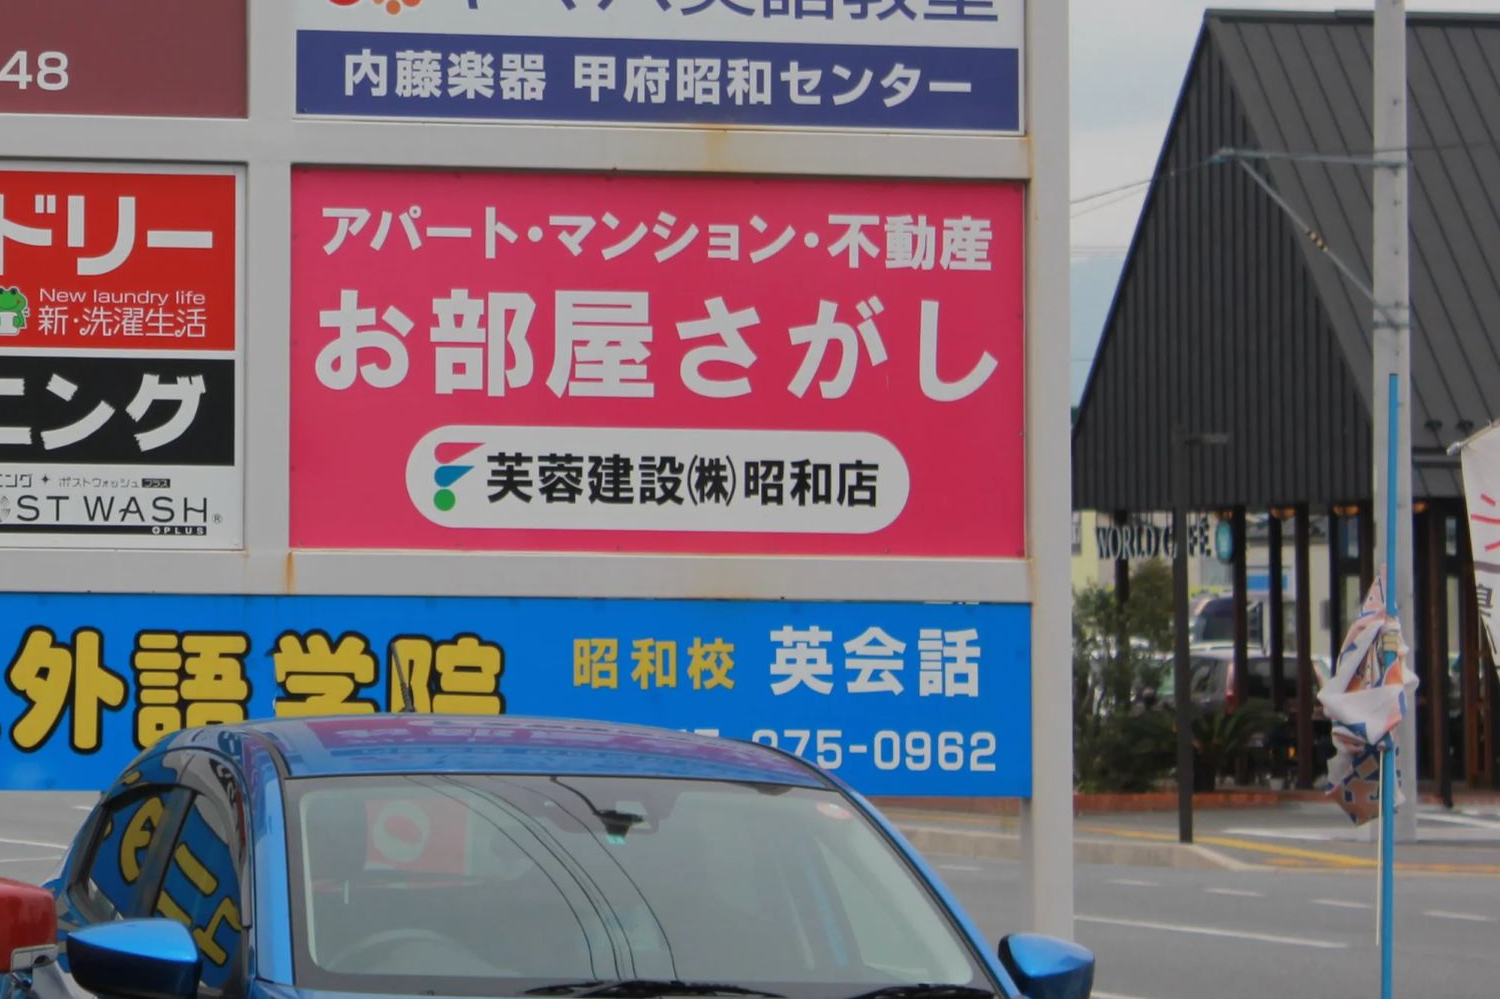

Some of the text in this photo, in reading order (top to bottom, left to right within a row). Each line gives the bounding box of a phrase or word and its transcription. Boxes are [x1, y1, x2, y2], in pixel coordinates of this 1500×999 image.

[343, 48, 972, 109] 内藤楽器 甲府昭和センター
[39, 288, 206, 306] New laundry life
[314, 288, 999, 402] お部屋さがし
[1095, 525, 1160, 560] WORLD
[573, 626, 981, 698] 昭和校 英会話
